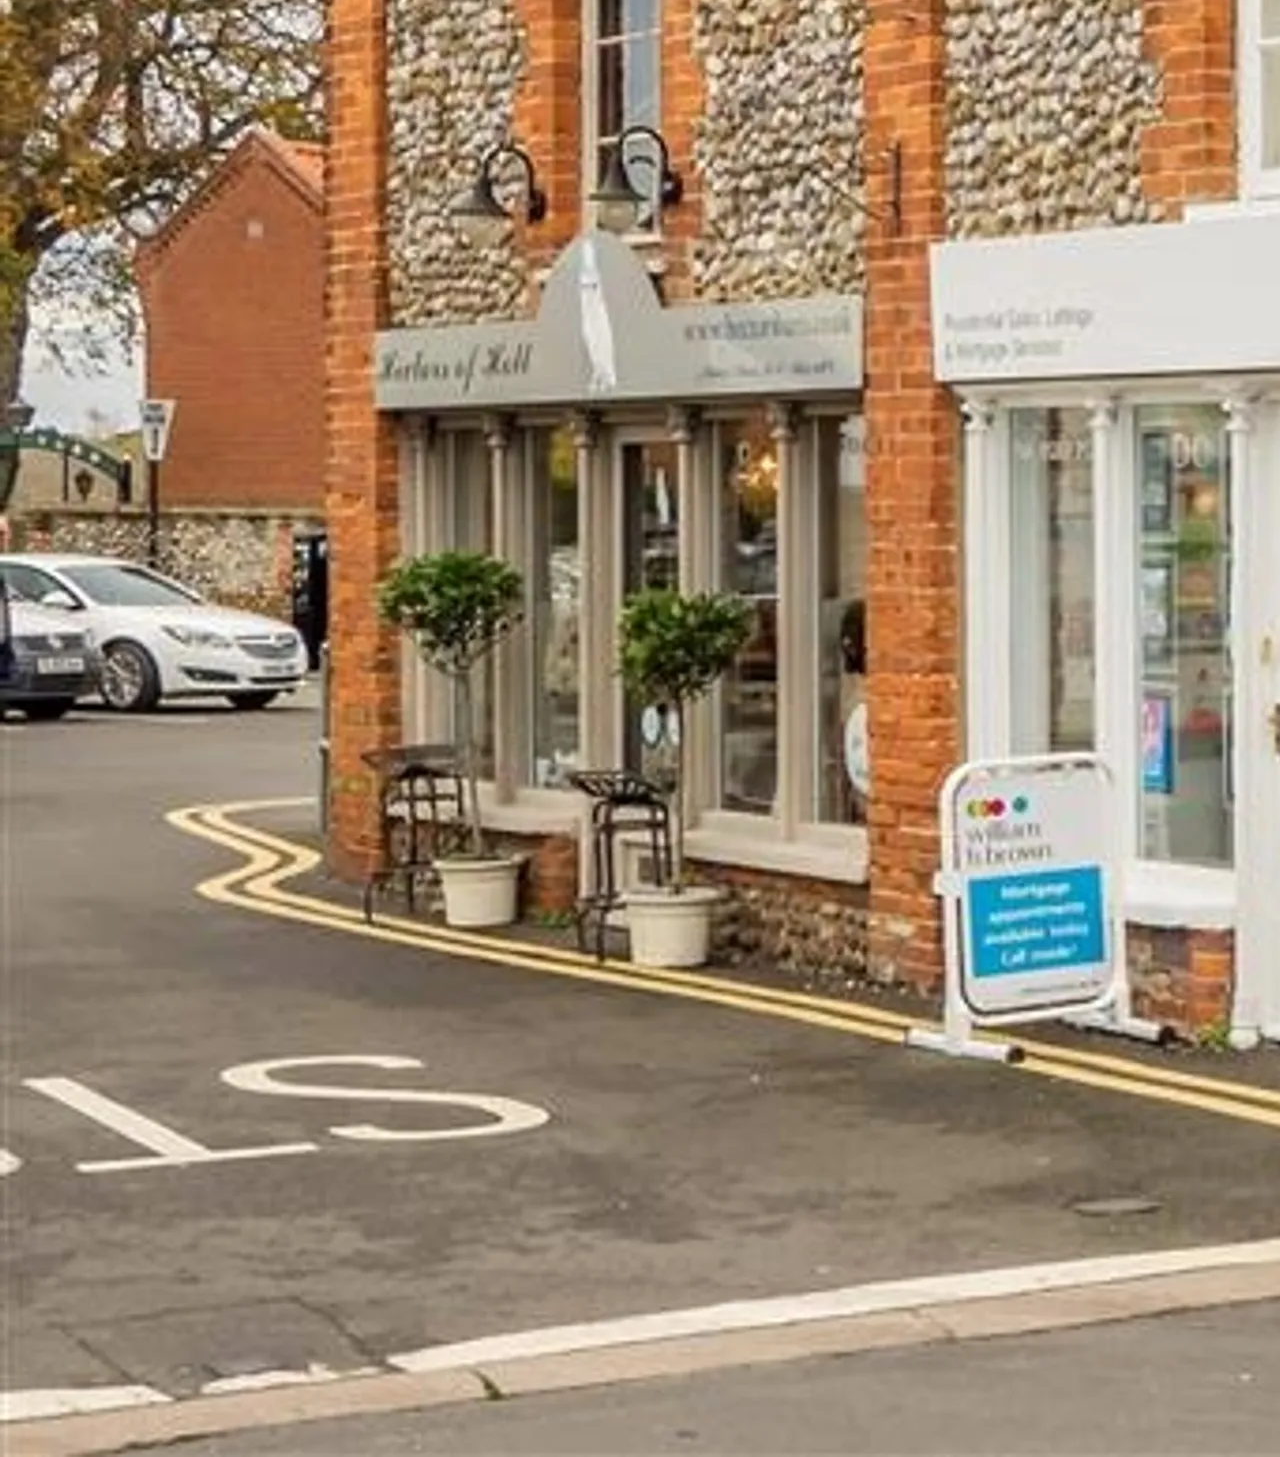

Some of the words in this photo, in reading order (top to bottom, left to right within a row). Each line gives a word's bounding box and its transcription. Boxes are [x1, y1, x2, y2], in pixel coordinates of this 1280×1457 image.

[945, 312, 1002, 330] Residential
[1046, 307, 1094, 329] Lettings
[957, 341, 1008, 363] Mortgage
[1012, 338, 1065, 358] Services
[965, 821, 1042, 844] william
[986, 845, 1053, 866] brown
